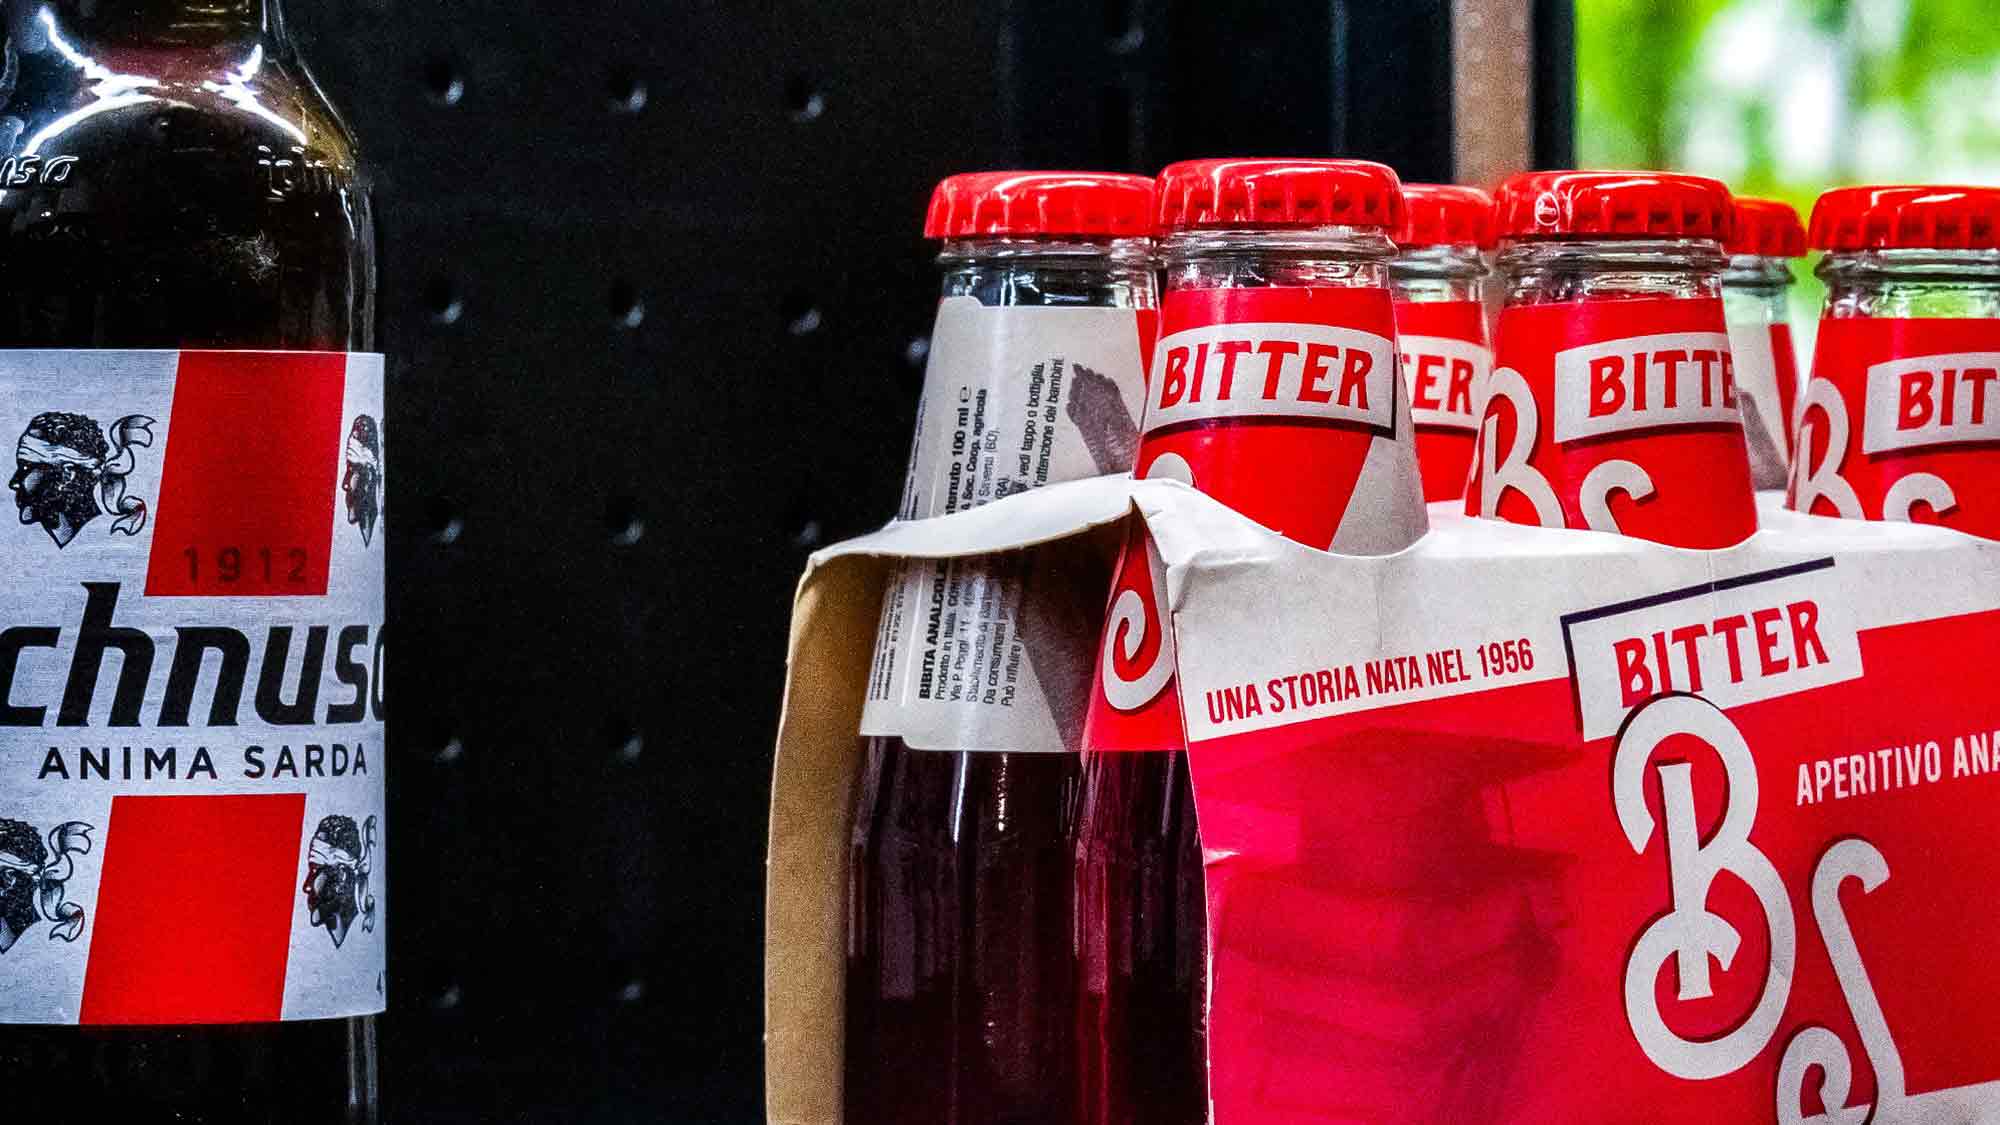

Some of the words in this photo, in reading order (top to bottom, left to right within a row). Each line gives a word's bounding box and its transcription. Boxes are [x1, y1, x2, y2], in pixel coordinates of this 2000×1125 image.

[1159, 339, 1375, 411] BITTER
[1402, 353, 1473, 416] ER
[957, 407, 970, 428] ml
[973, 387, 988, 437] agricola
[1896, 367, 1998, 432] BIT
[952, 430, 967, 456] 100
[1022, 421, 1038, 452] tappo
[1018, 454, 1032, 477] vedi
[183, 546, 310, 584] 1912
[919, 648, 937, 699] BIBITA
[935, 654, 951, 700] Prodotto
[1613, 599, 1830, 708] BITTER
[950, 684, 963, 702] Via
[1206, 683, 1263, 724] UNA
[1267, 664, 1361, 714] STORIA
[1365, 655, 1424, 696] NATA
[1426, 648, 1472, 686] NEL
[1476, 637, 1536, 678] 1956
[37, 746, 219, 781] ANIMA
[243, 742, 369, 779] SARDA
[1795, 740, 1942, 806] APERITIVO
